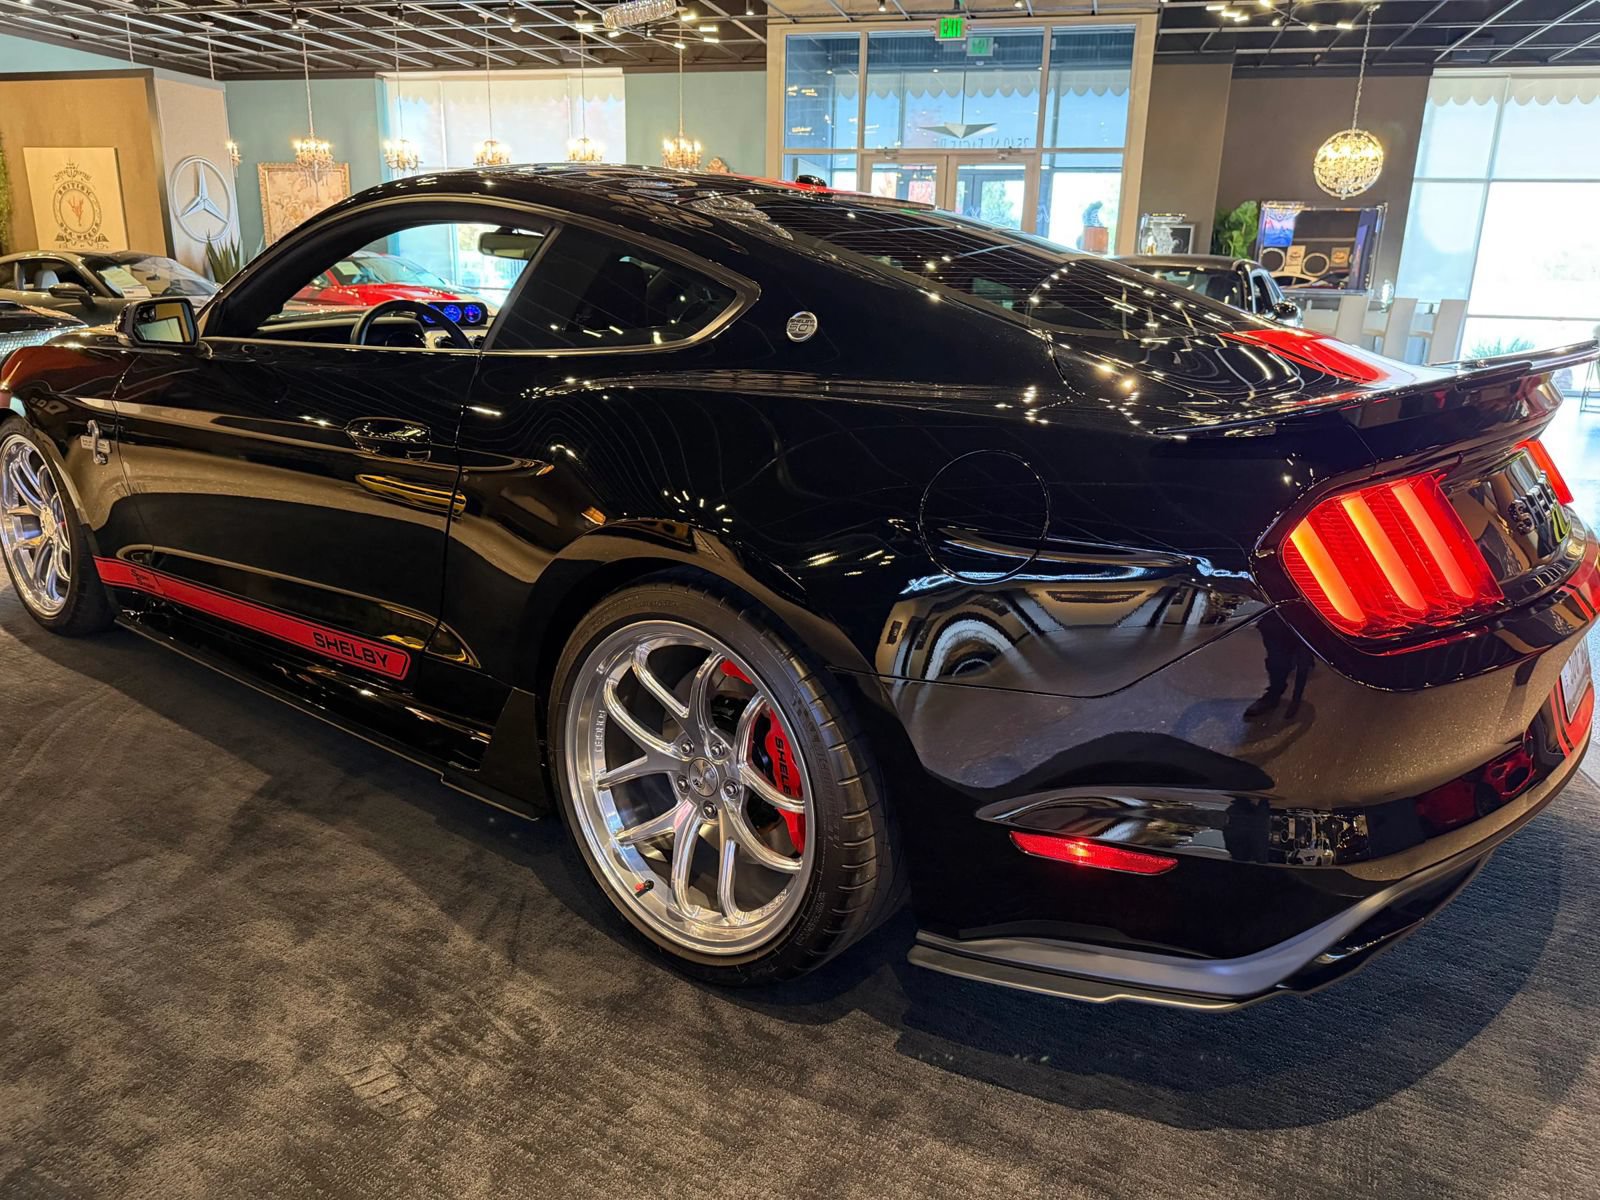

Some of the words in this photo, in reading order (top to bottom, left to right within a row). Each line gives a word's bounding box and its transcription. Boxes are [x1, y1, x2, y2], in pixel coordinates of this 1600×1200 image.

[940, 17, 963, 38] EXIT
[313, 631, 388, 668] SHELBY
[774, 735, 792, 796] SHELB
